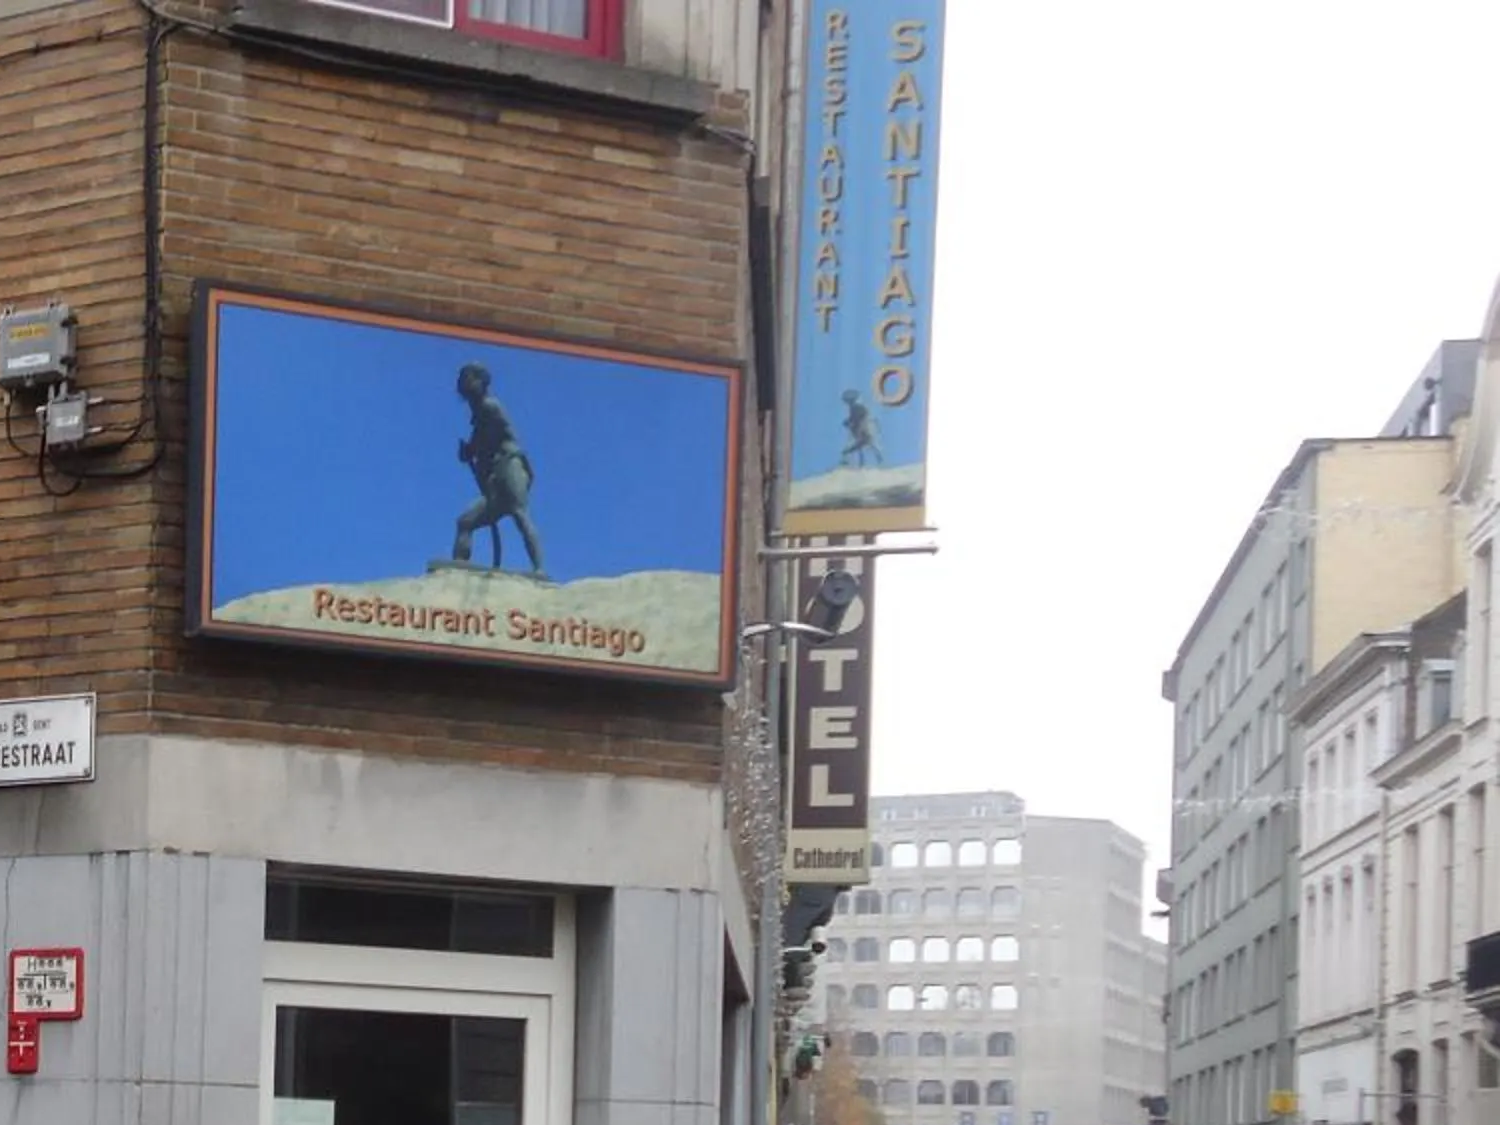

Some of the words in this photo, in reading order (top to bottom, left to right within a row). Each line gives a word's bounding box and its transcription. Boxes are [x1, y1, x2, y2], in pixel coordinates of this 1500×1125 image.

[813, 9, 850, 334] RESTAURANT
[871, 19, 928, 408] SANTIAGO
[313, 588, 496, 638] Restaurant
[506, 607, 646, 657] Santiago
[793, 847, 864, 869] Cathedral
